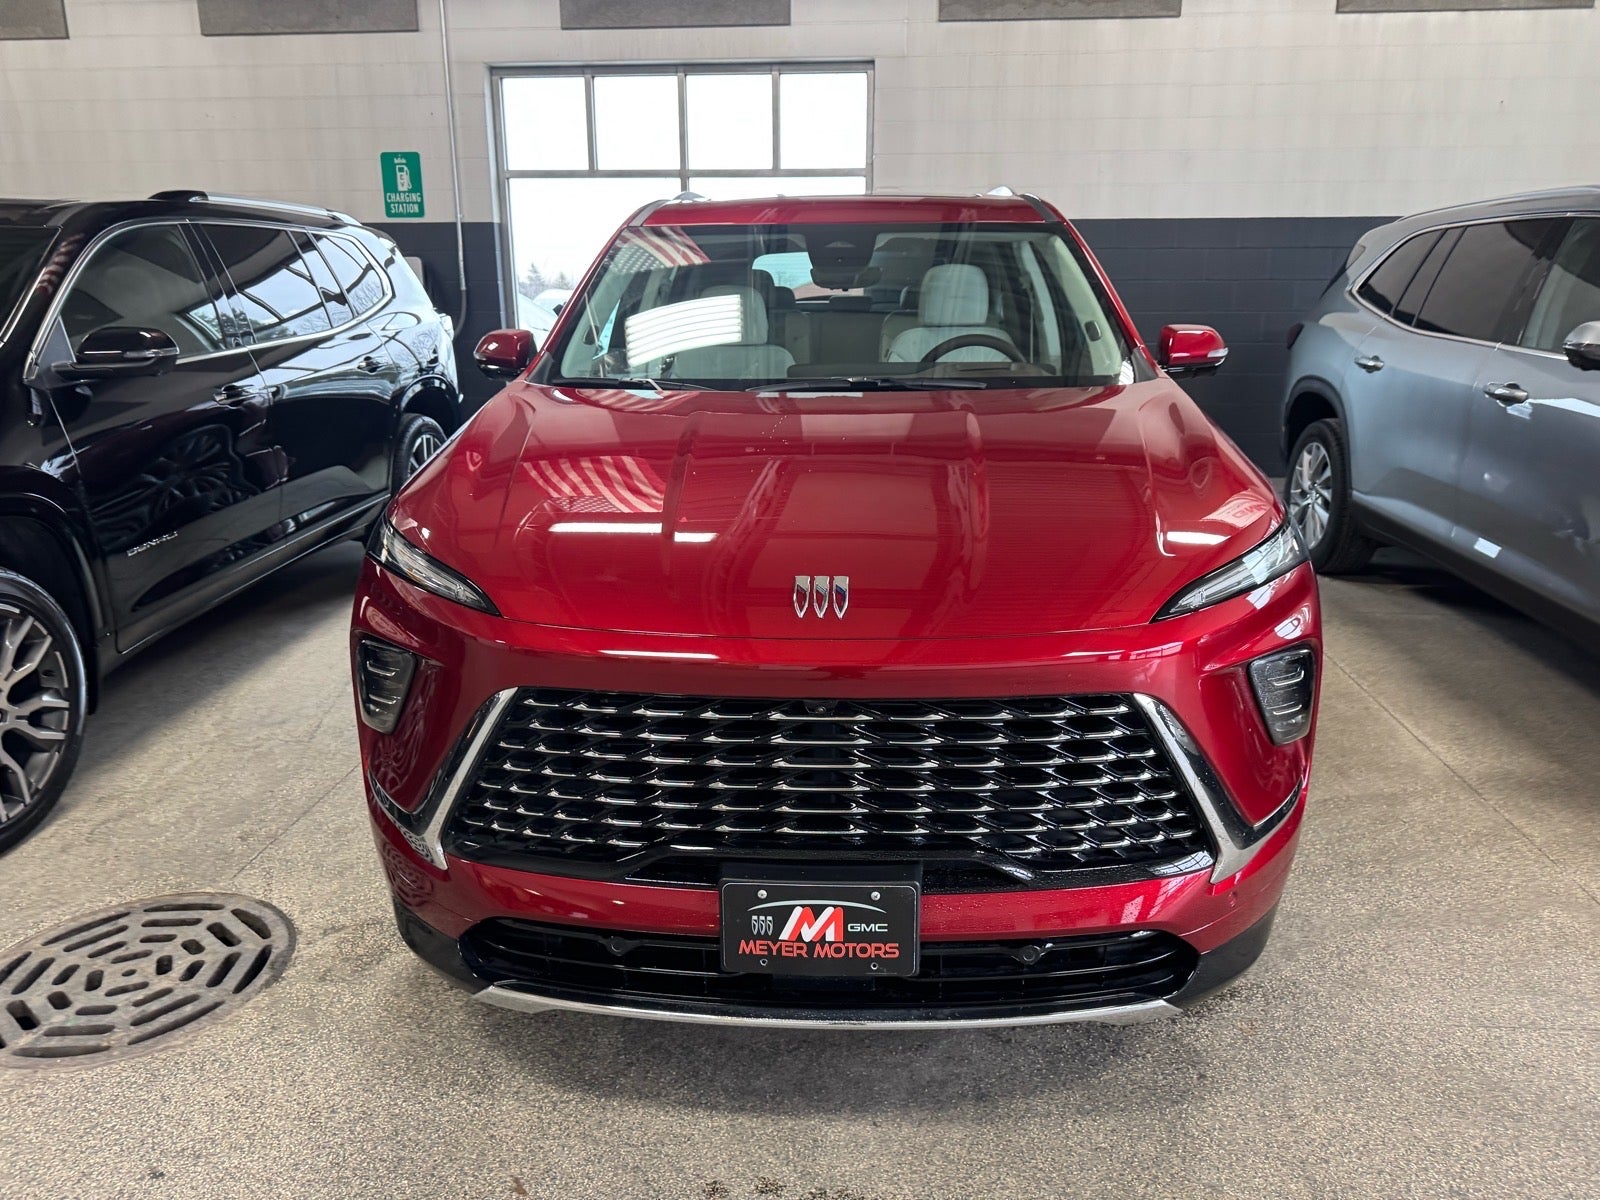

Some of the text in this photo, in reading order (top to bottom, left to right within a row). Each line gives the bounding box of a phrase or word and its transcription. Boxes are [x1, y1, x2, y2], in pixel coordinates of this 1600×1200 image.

[386, 192, 421, 203] CHARGING
[390, 203, 419, 214] STATION
[847, 923, 889, 932] GMC
[738, 939, 900, 959] MEYER MOTORS
